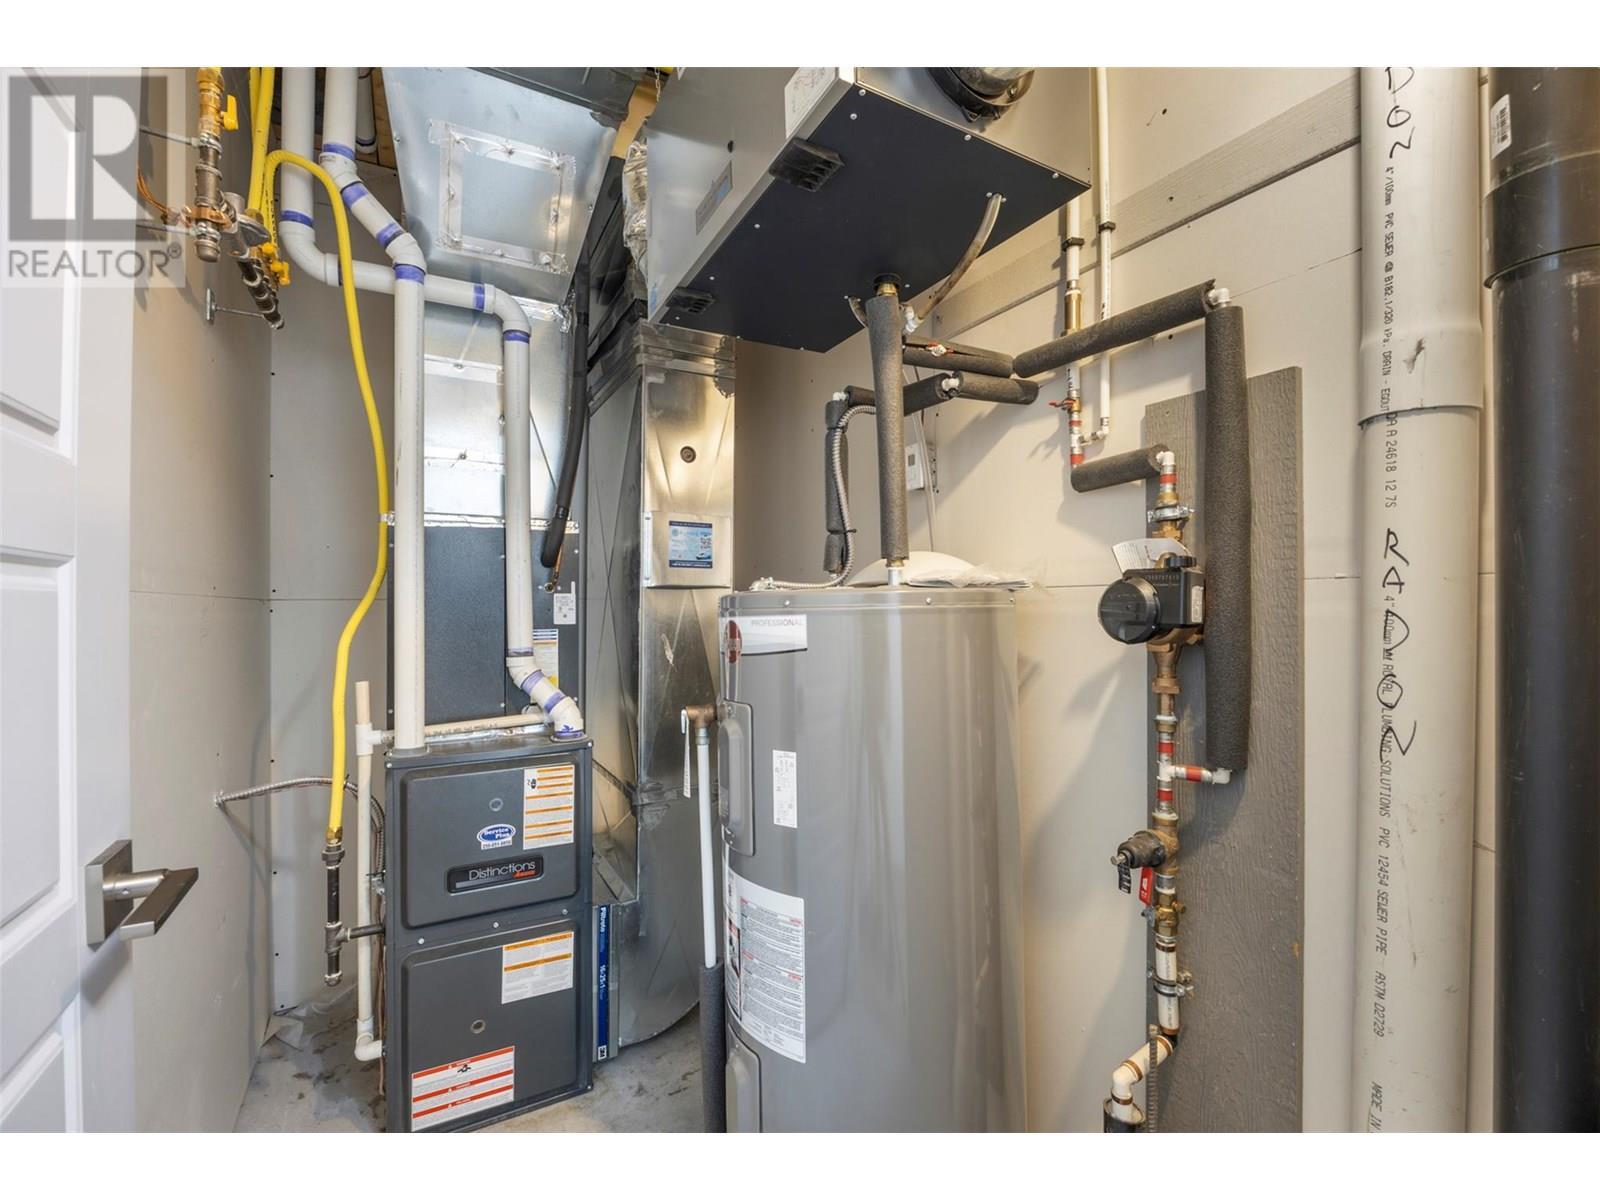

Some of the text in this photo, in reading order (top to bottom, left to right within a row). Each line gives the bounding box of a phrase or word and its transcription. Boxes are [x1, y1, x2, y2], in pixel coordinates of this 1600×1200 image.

[1384, 212, 1394, 229] PVC
[1384, 232, 1394, 257] SEWER
[1382, 351, 1392, 376] DRAIN
[1385, 441, 1398, 473] 24618
[1378, 760, 1392, 817] SOLUTIONS
[1378, 827, 1390, 848] PVC
[469, 862, 536, 881] Distinctions
[1377, 855, 1390, 887] 12454
[1376, 889, 1389, 921] SEWER
[1375, 927, 1388, 955] PIPE
[1374, 971, 1386, 1000] ASTM
[1373, 1001, 1386, 1038] D2729
[1370, 1081, 1383, 1112] MADE
[1370, 1115, 1382, 1130] IN
